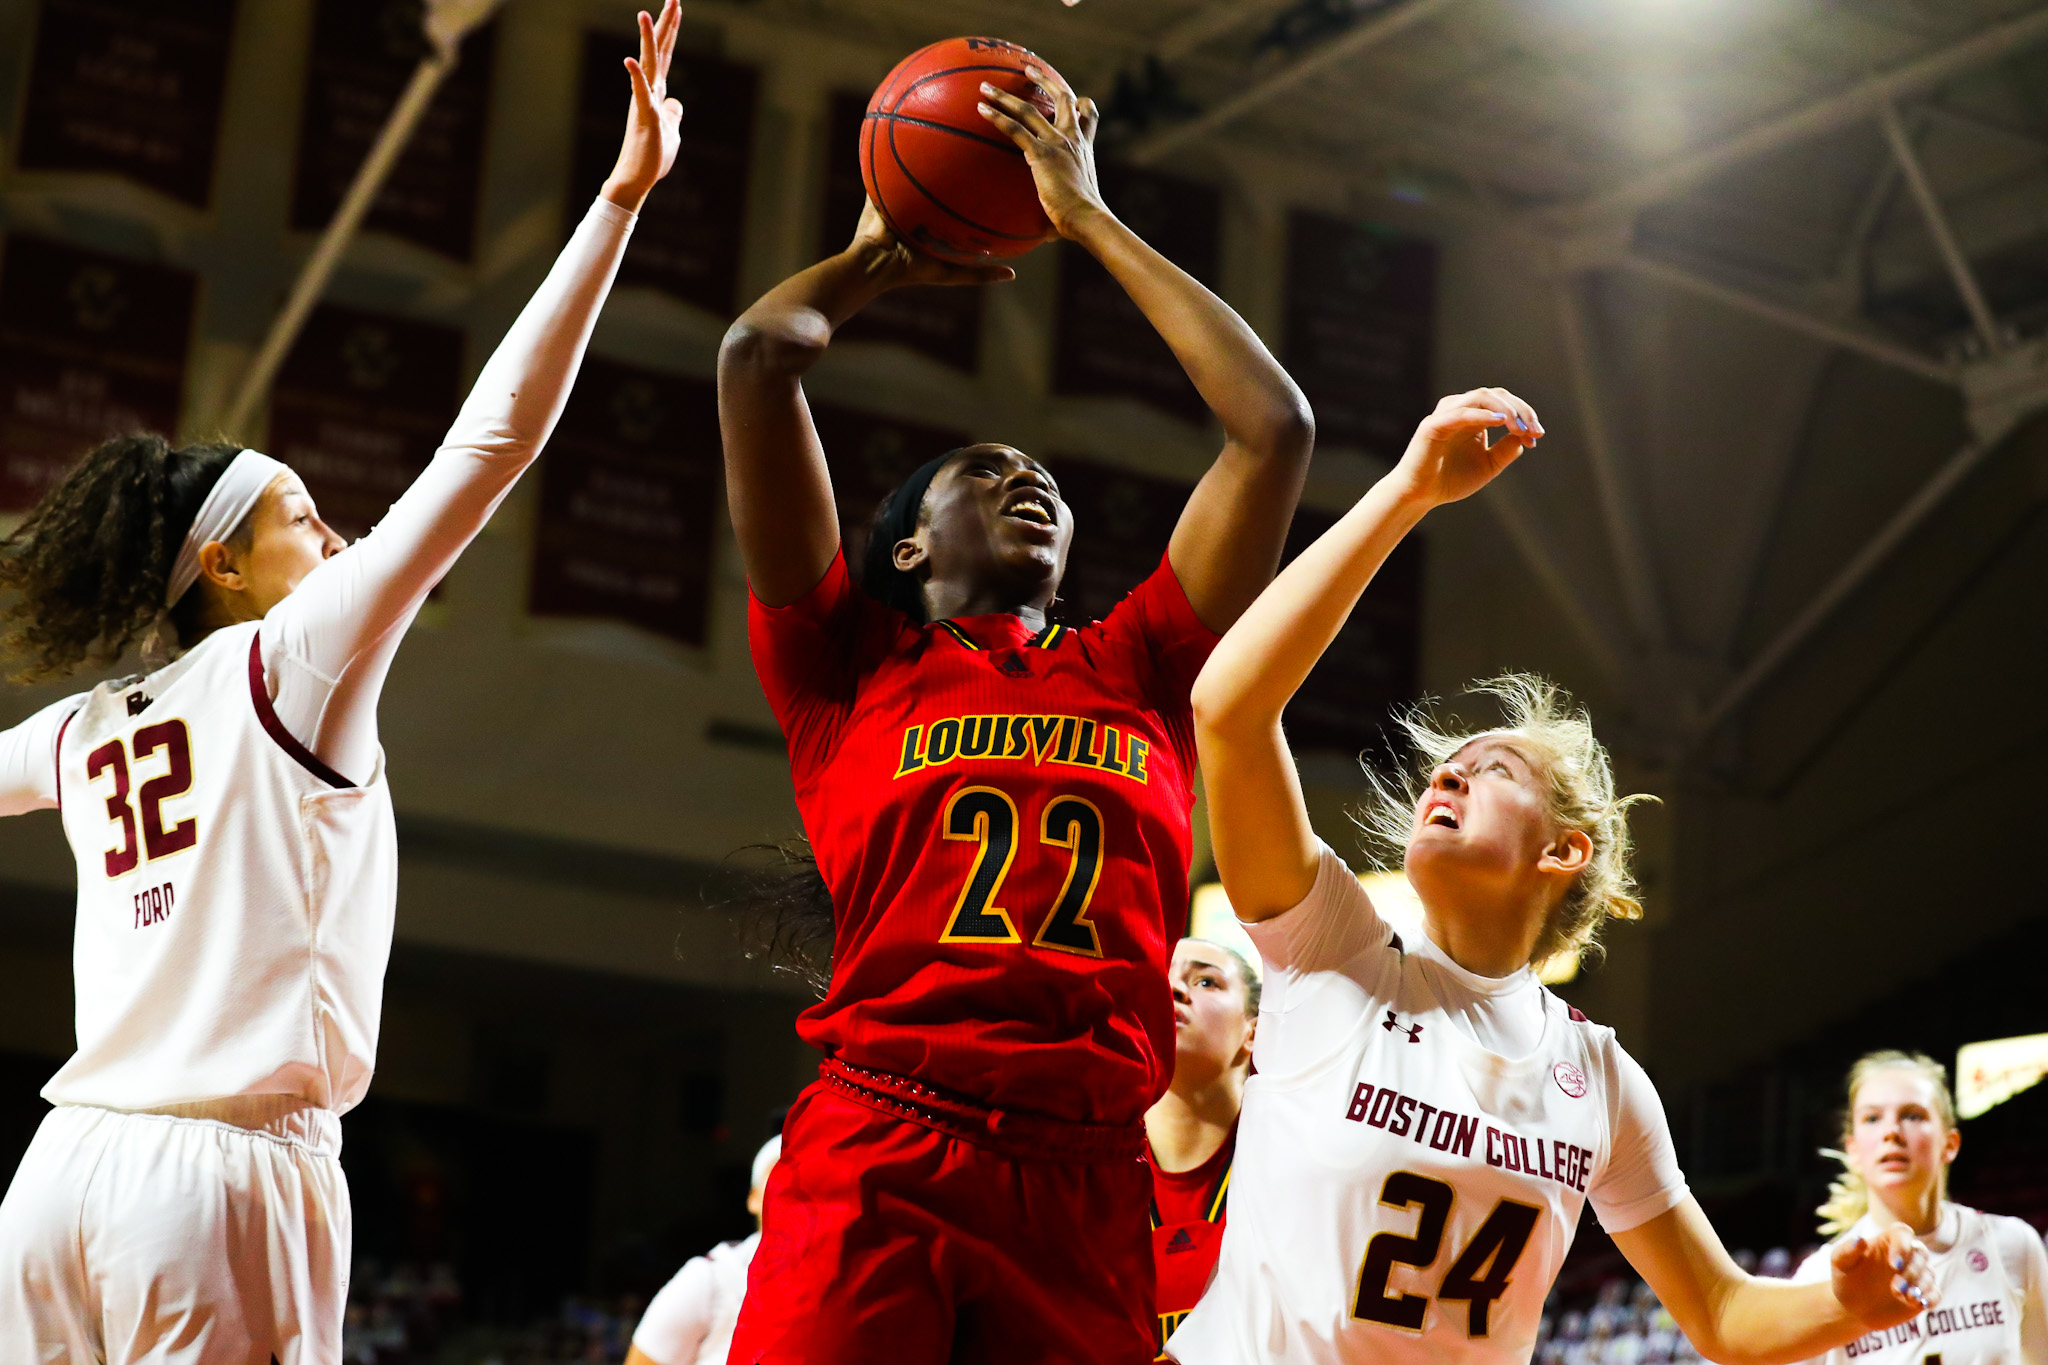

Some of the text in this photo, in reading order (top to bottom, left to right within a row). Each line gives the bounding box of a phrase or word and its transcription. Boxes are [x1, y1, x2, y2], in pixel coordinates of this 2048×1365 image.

[87, 717, 198, 881] 32
[893, 714, 1149, 785] LOUISVILLE
[134, 882, 174, 929] FORD
[938, 785, 1104, 958] 22
[1345, 1082, 1592, 1193] BOSTON COLLEGE
[1351, 1169, 1544, 1340] 24
[1926, 1300, 2004, 1338] COLLEGE
